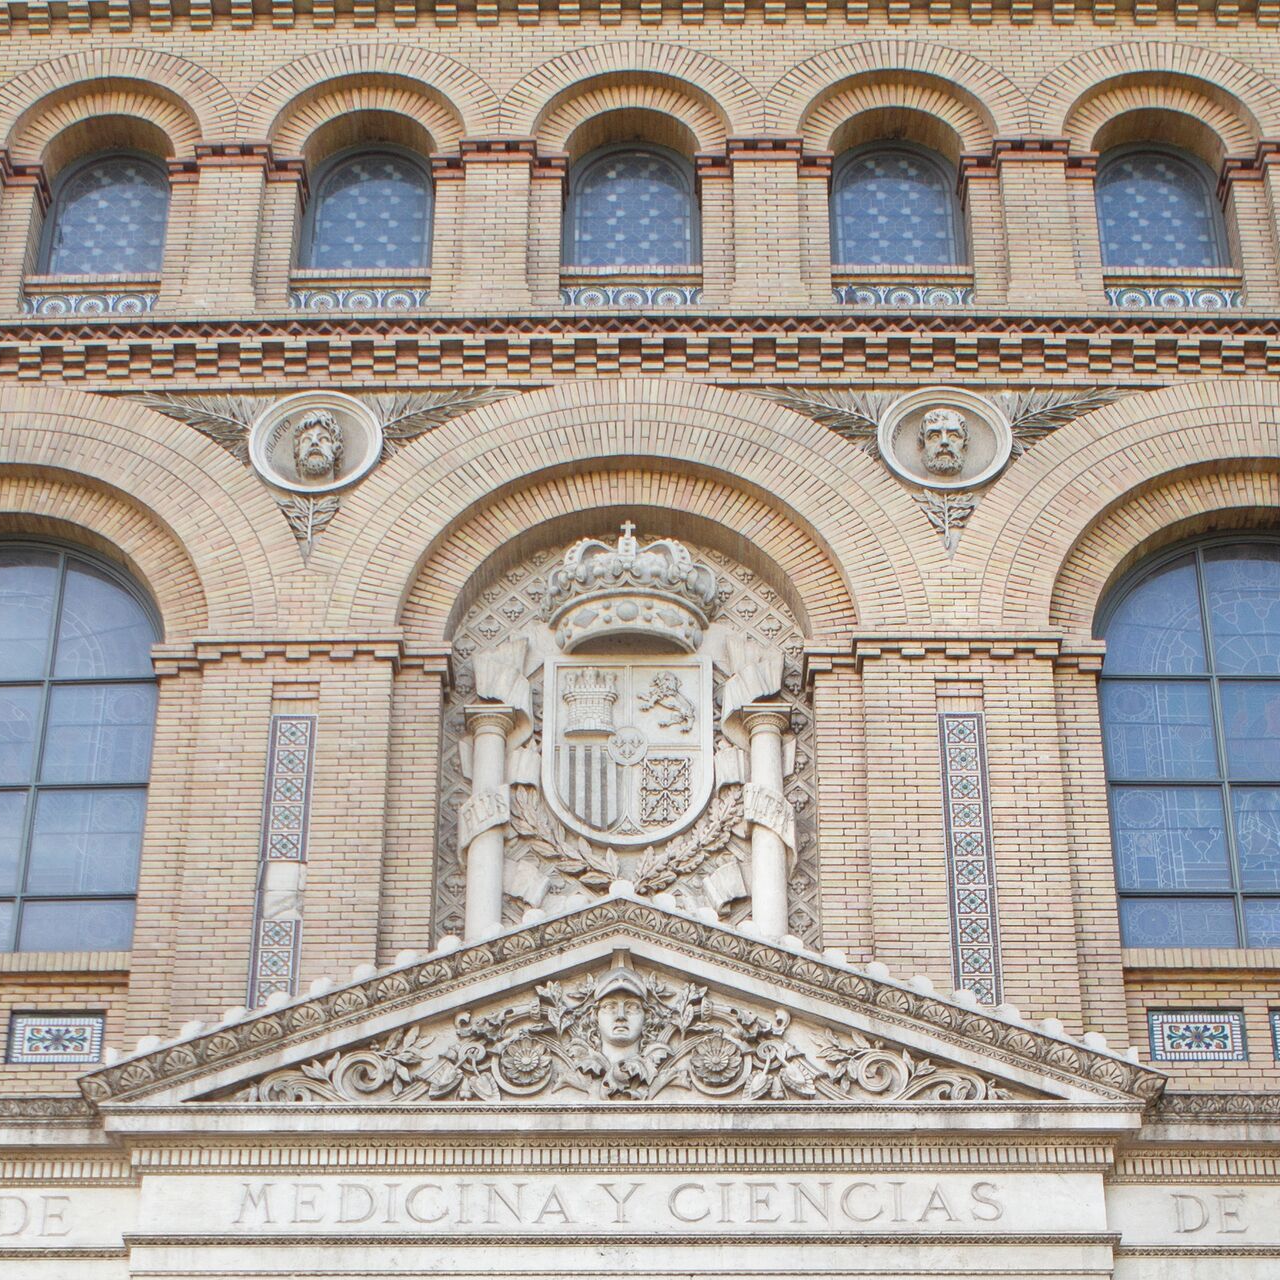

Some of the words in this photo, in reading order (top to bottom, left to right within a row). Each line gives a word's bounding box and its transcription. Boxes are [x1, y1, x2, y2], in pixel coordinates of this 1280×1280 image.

[231, 1180, 570, 1226] MEDICINA
[592, 1180, 647, 1225] Y
[666, 1179, 1007, 1226] CIENCIAS
[1170, 1193, 1250, 1235] DE
